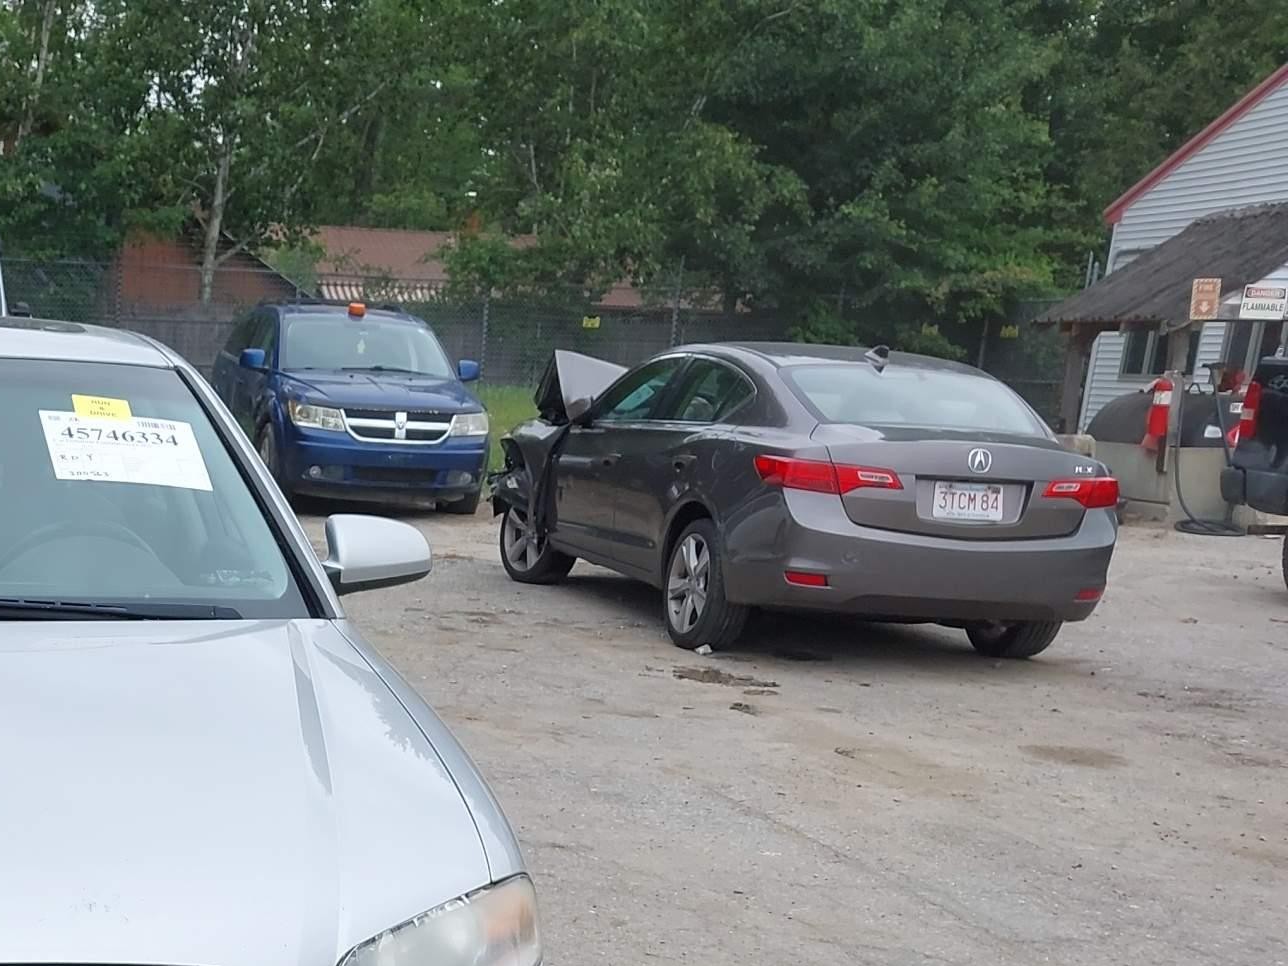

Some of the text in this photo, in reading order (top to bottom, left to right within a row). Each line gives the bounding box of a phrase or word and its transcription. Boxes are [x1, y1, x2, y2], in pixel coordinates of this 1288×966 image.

[1251, 288, 1282, 297] DANGER
[1242, 302, 1284, 312] FLAMMABLE
[61, 426, 179, 447] 45746334
[938, 491, 999, 512] 3TCM 84
